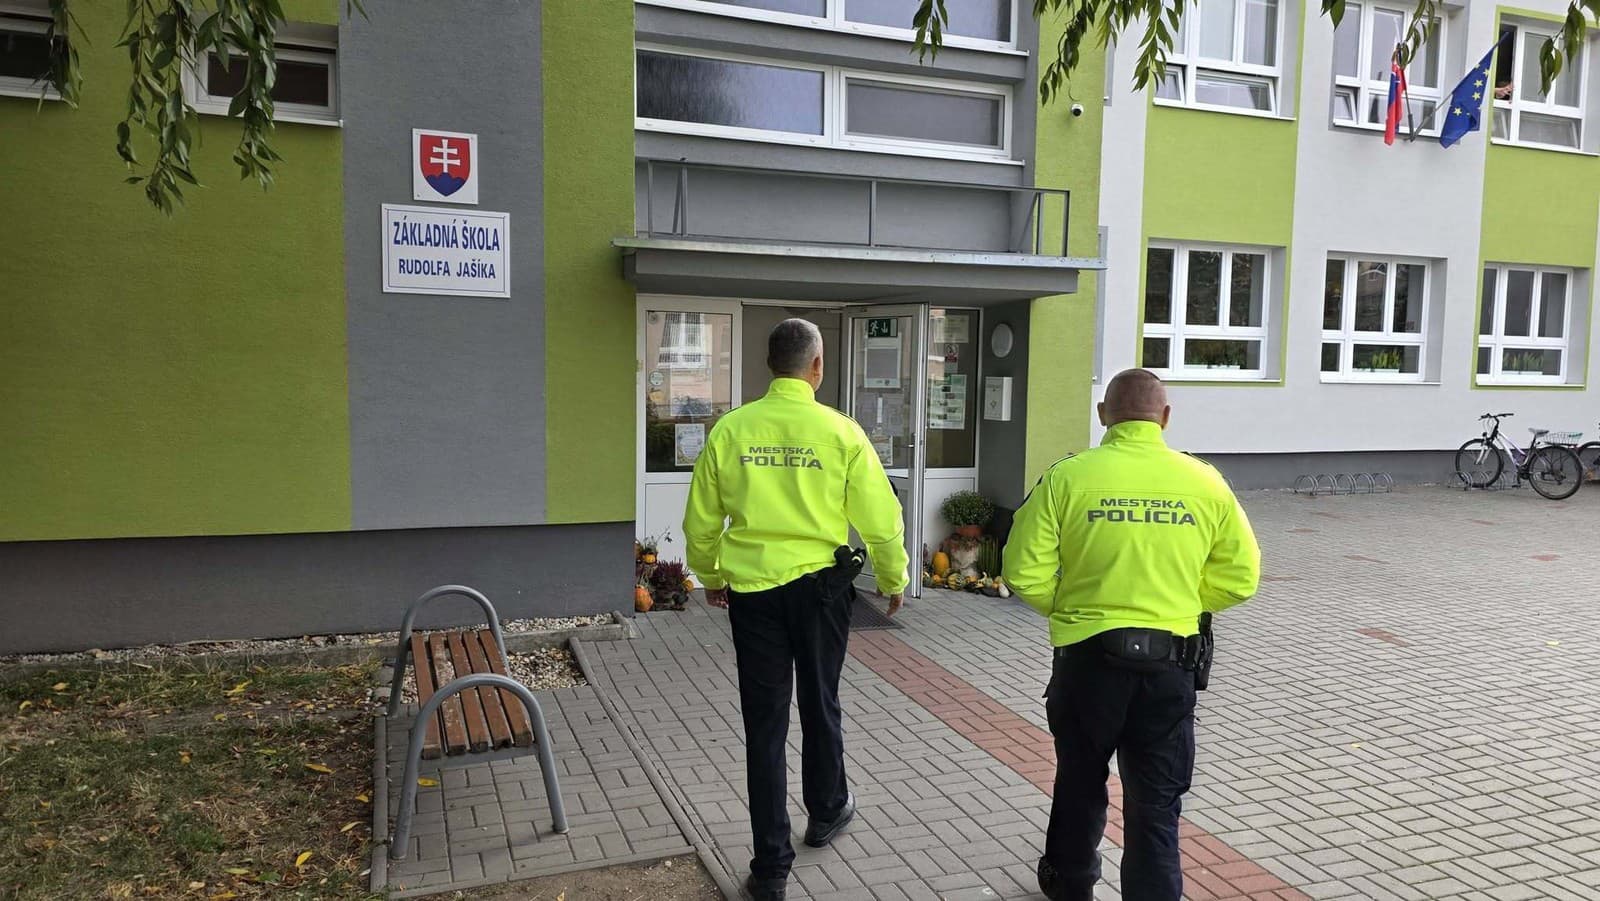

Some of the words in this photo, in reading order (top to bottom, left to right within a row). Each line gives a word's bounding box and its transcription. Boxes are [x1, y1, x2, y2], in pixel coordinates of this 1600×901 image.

[393, 216, 458, 249] ZÁKLADNÁ
[462, 219, 500, 251] ŠKOLA
[398, 258, 451, 277] RUDOLFA
[456, 258, 496, 279] JAŠÍKA
[740, 454, 823, 470] POLÍCIA
[1087, 508, 1196, 526] POLÍCIA
